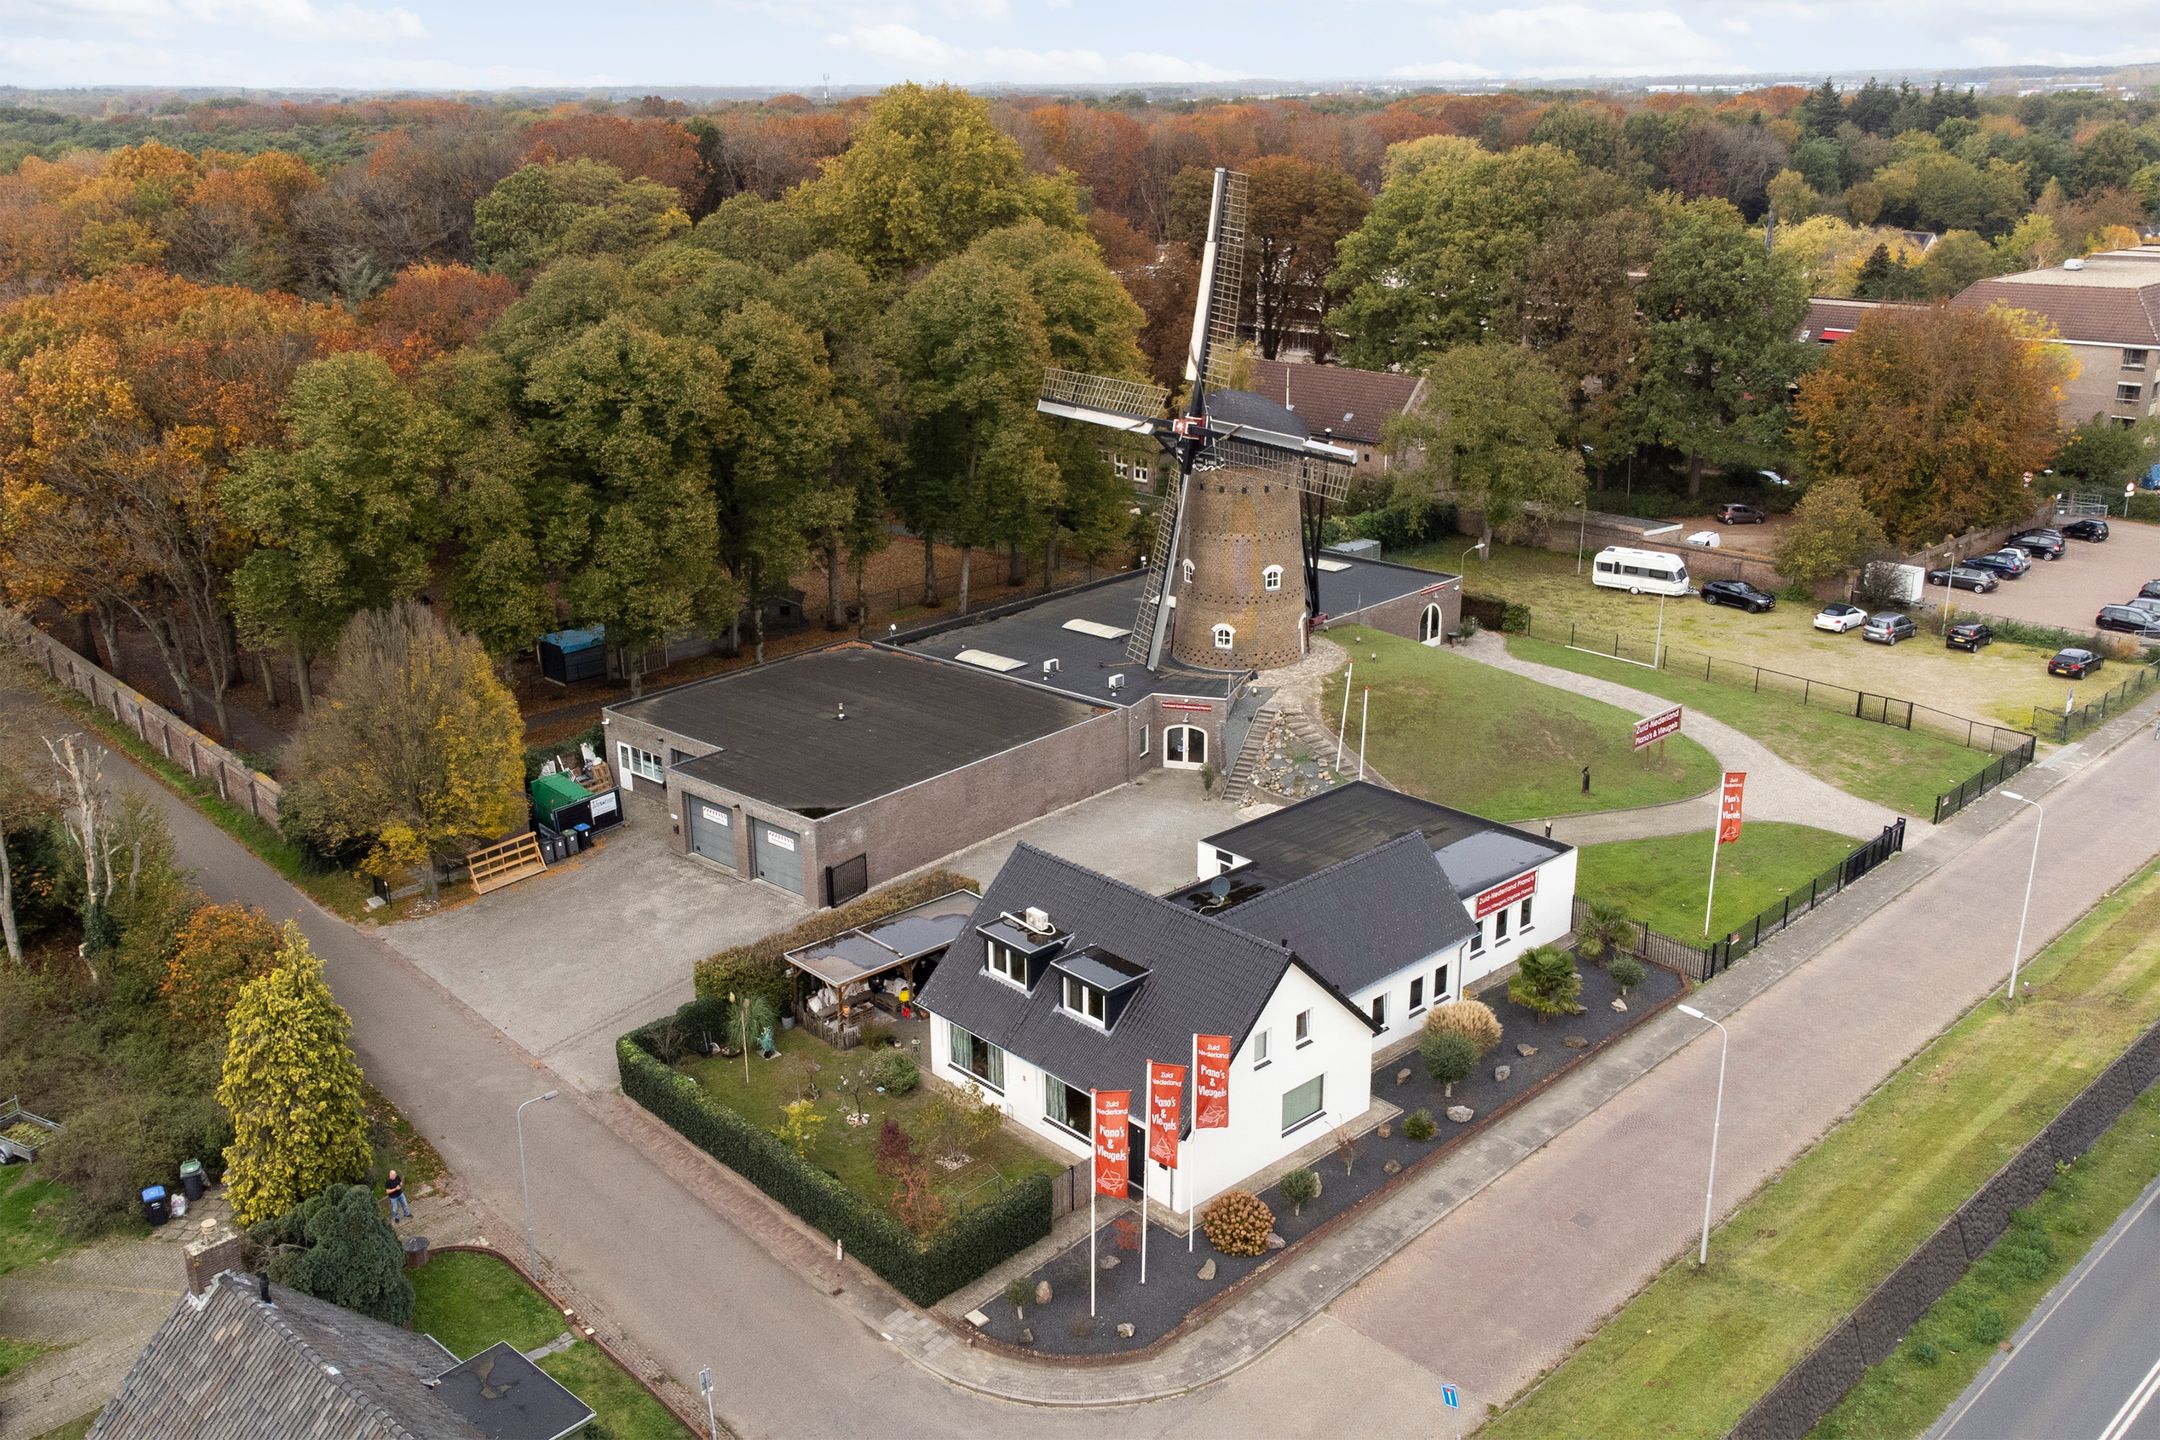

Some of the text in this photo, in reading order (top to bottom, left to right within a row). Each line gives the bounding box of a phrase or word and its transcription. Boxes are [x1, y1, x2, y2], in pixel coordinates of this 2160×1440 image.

[1200, 1064, 1225, 1079] Piano's
[1210, 1078, 1216, 1086] &
[1198, 1085, 1227, 1099] Vleugels
[1106, 1100, 1119, 1108] Zuid
[1160, 1108, 1166, 1118] &
[1152, 1113, 1176, 1132] Vlegels
[1107, 1139, 1114, 1149] &
[1097, 1145, 1126, 1163] Vleugels
